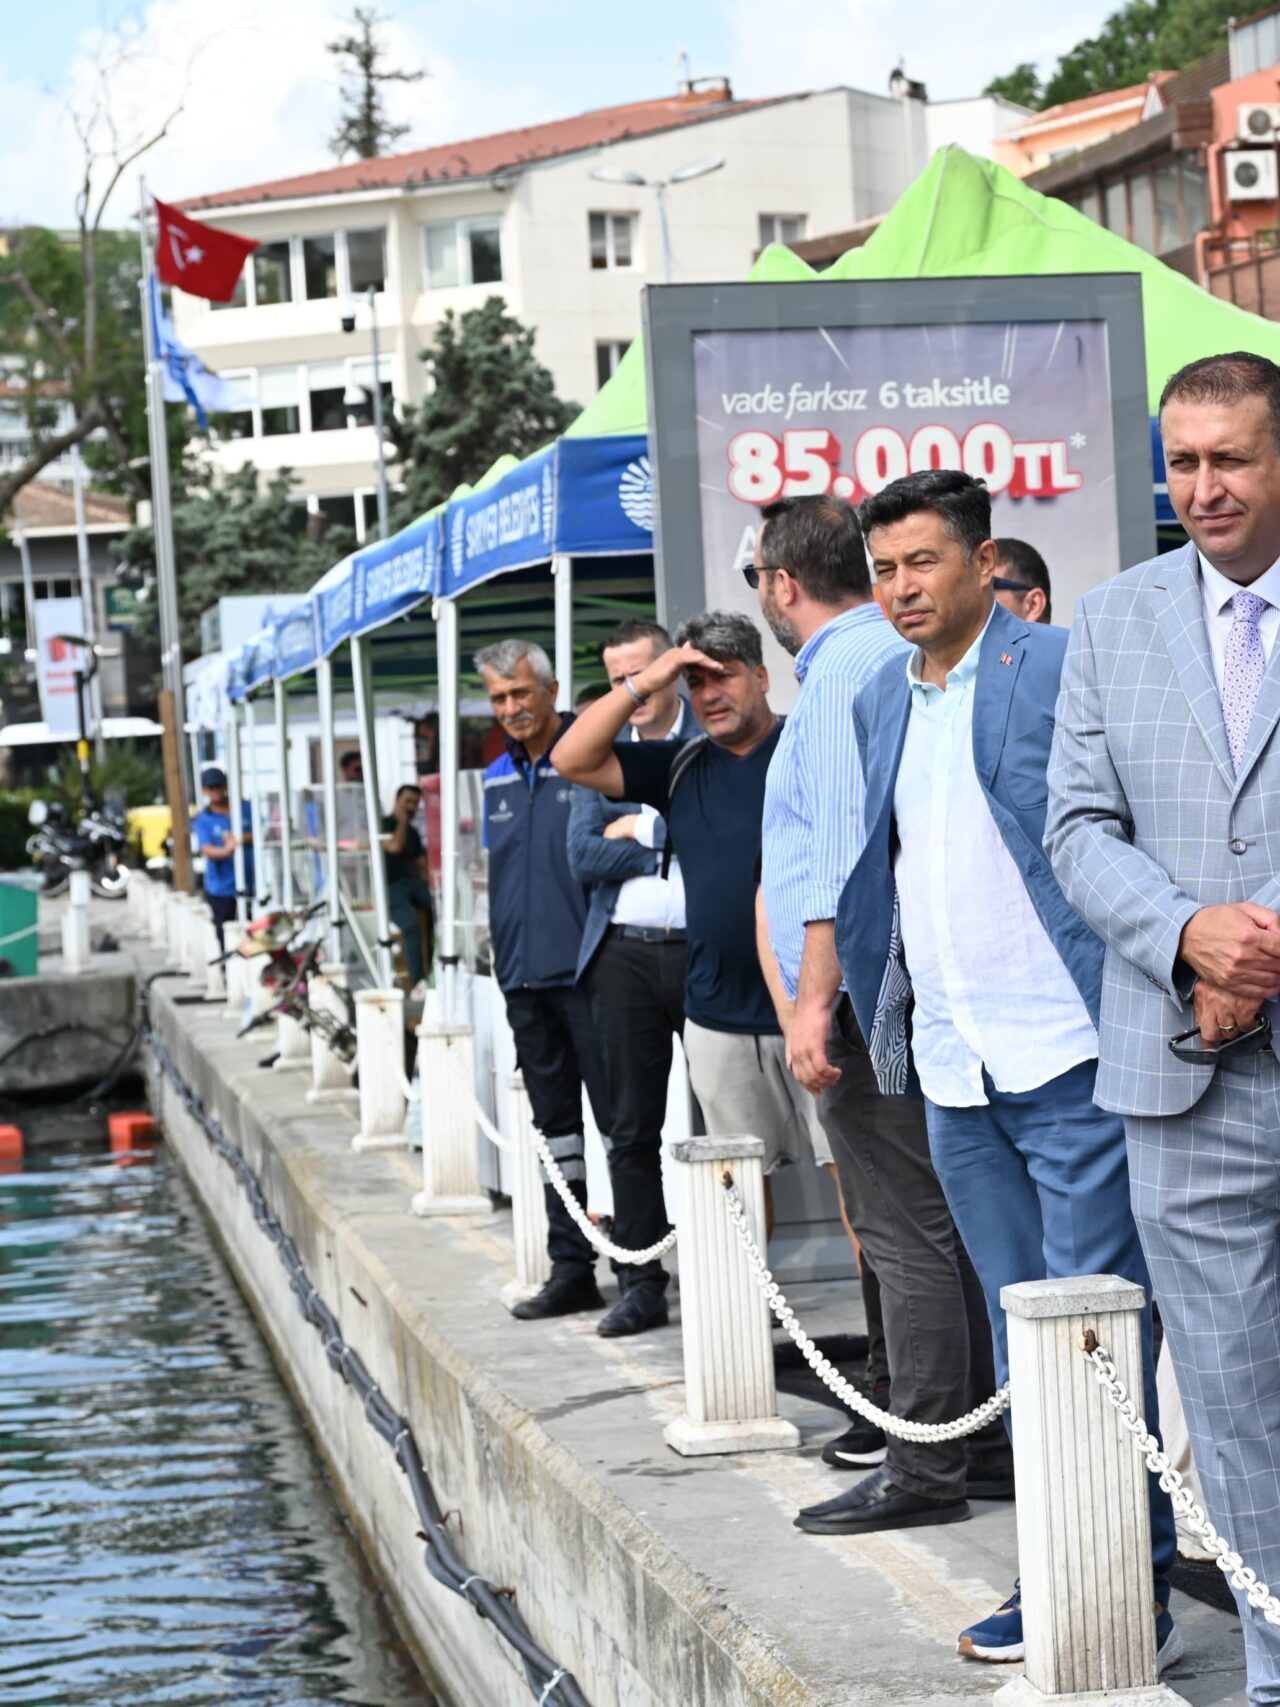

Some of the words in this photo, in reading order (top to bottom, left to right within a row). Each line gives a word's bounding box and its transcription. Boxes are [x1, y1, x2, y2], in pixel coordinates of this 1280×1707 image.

[721, 383, 784, 415] vade
[879, 380, 900, 409] 6
[903, 376, 1011, 408] taksitle
